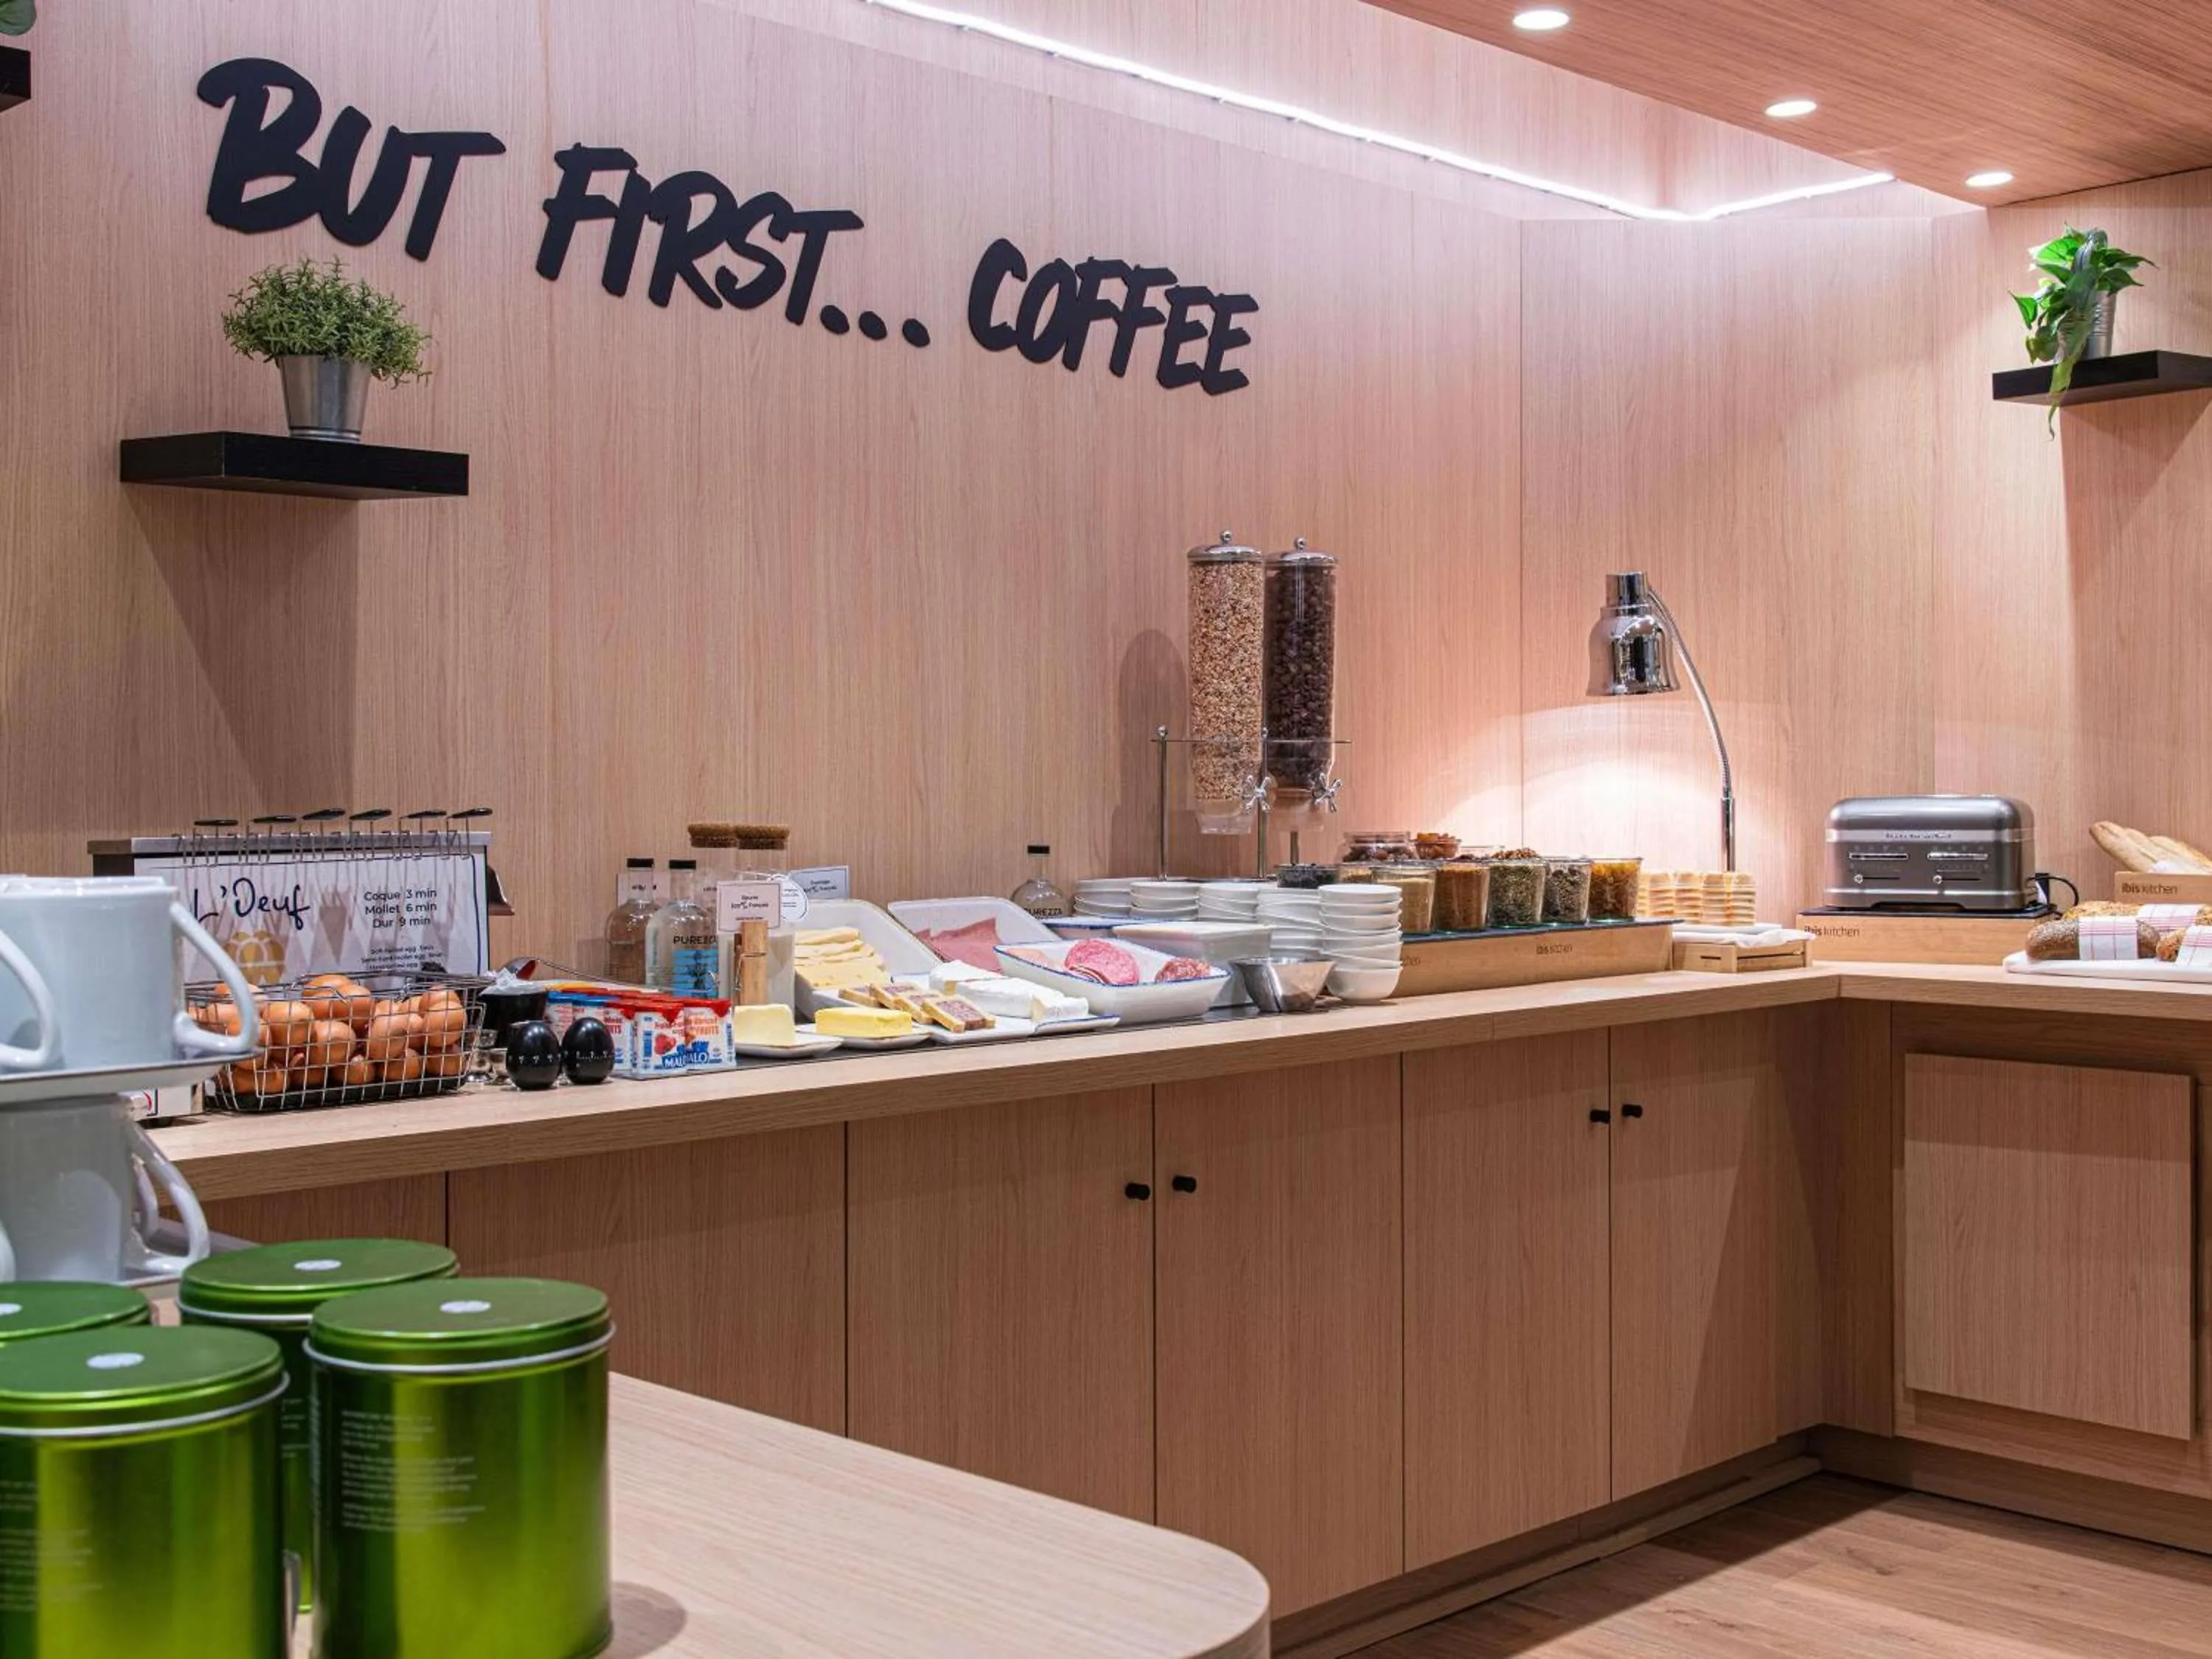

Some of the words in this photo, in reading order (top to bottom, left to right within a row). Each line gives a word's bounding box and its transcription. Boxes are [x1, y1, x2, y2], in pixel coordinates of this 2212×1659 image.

[197, 58, 507, 262] BUT
[967, 238, 1259, 396] COFFEE
[364, 891, 401, 901] Coque
[406, 889, 413, 899] 3
[415, 888, 437, 898] min
[365, 904, 400, 914] Mollet
[406, 903, 414, 912] 6
[415, 902, 437, 911] min
[372, 917, 394, 928] Dur
[399, 917, 406, 927] 9
[409, 915, 431, 925] min
[1823, 925, 1860, 937] kitchen
